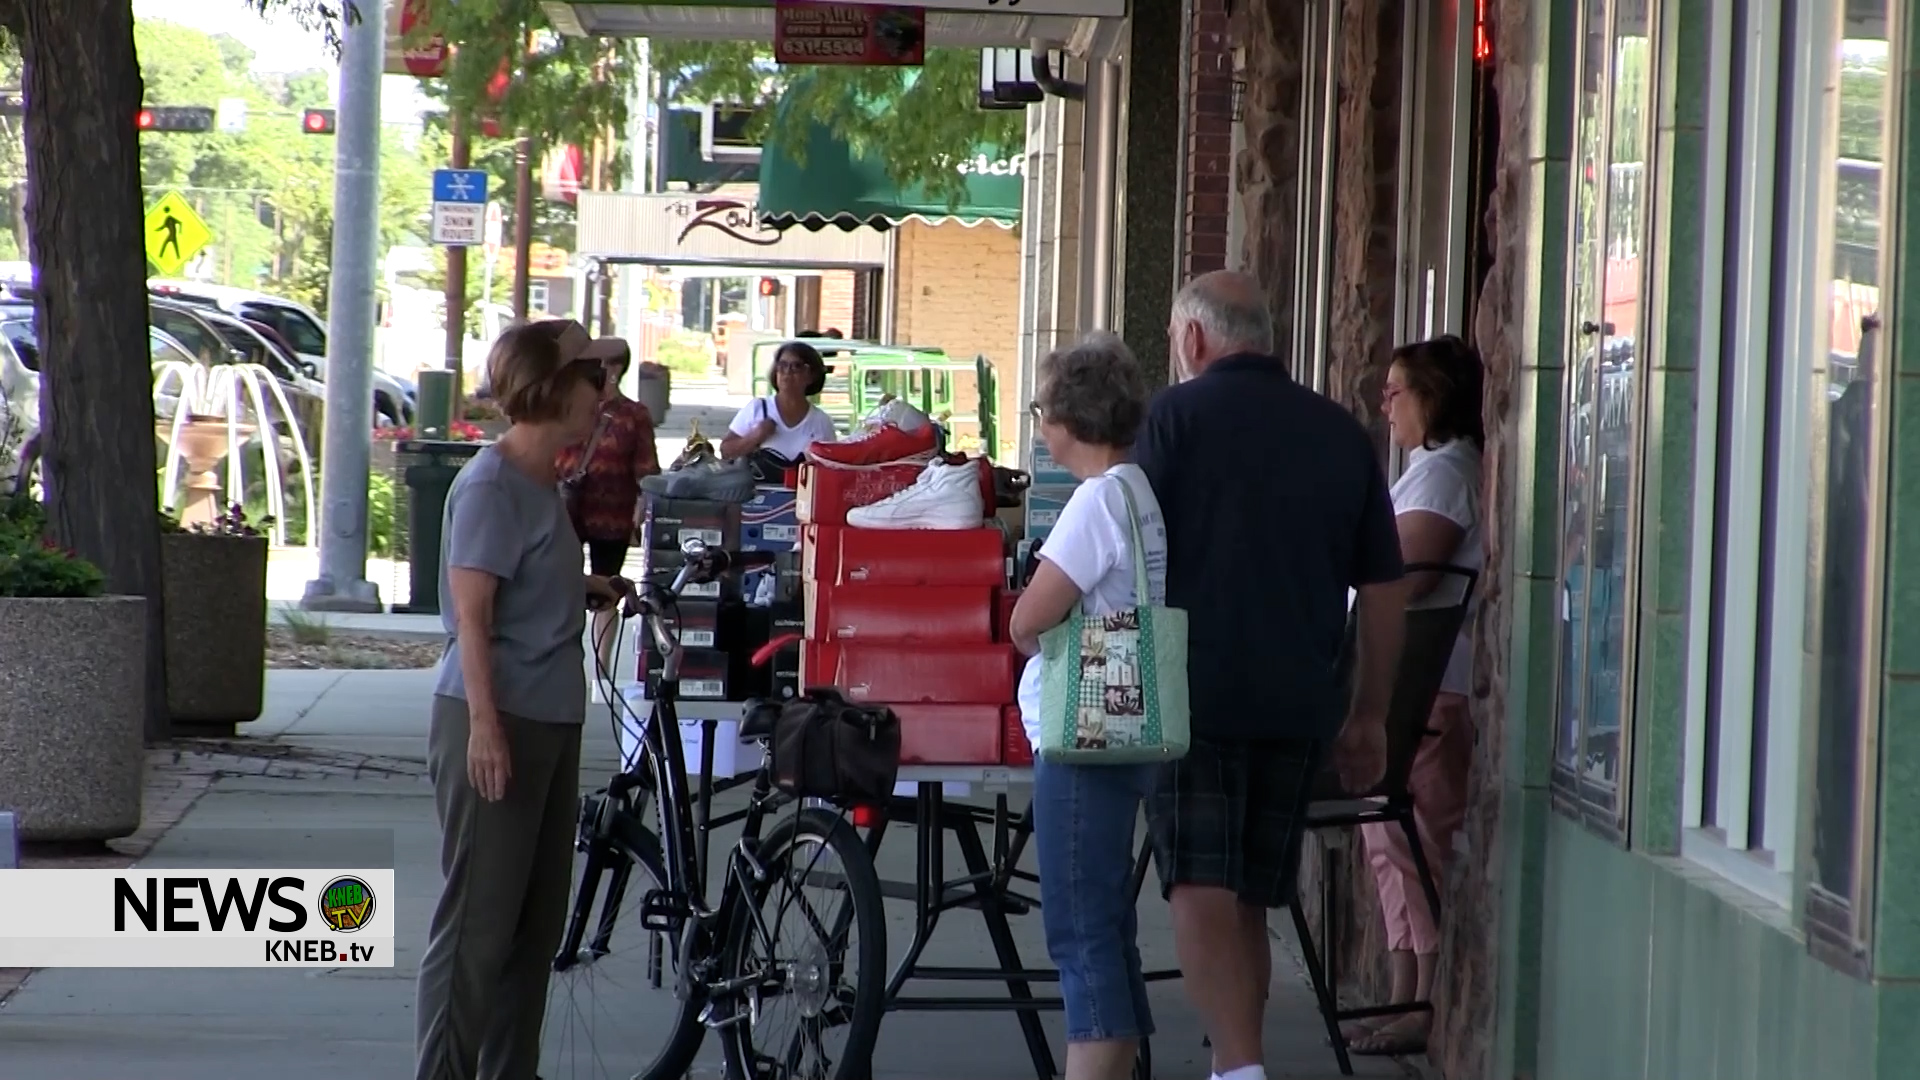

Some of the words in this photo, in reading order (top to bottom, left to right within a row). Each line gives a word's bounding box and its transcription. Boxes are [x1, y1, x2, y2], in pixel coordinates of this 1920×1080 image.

[786, 25, 821, 34] OFFICE
[443, 215, 474, 227] SNOW
[441, 228, 476, 240] ROUTE
